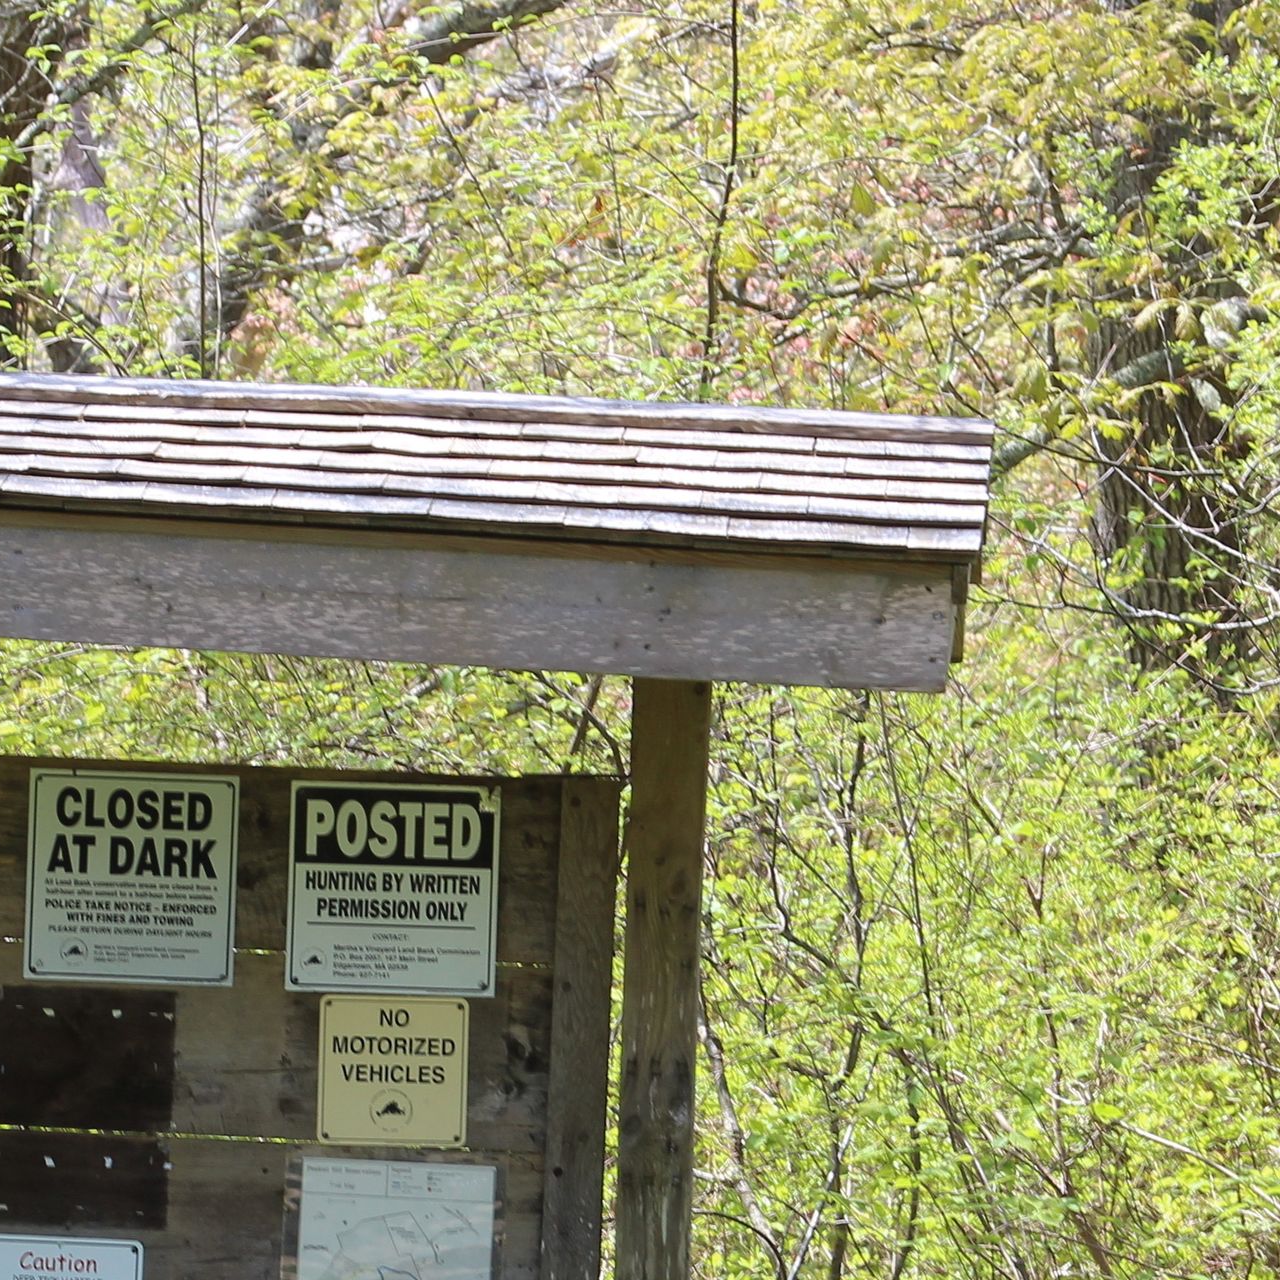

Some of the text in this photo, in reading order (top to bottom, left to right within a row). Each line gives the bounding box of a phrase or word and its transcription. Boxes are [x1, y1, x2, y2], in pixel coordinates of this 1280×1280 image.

[56, 787, 213, 831] CLOSED
[305, 798, 481, 861] POSTED
[47, 834, 217, 878] AT DARK
[305, 870, 480, 895] HUNTING BY WRITTEN
[45, 898, 81, 909] POLICE
[85, 899, 111, 911] TAKE
[114, 901, 152, 913] NOTICE
[162, 903, 217, 915] ENFORCED
[316, 898, 468, 921] PERMISSION ONLY
[66, 911, 194, 927] WITH FINES AND TOWING
[48, 924, 212, 939] PLEASE RETURN DURING DAYLIGHT HOURS
[380, 1008, 410, 1027] NO
[332, 1035, 456, 1057] MOTORIZED
[342, 1064, 445, 1084] VEHICLES
[19, 1250, 98, 1273] Caution
